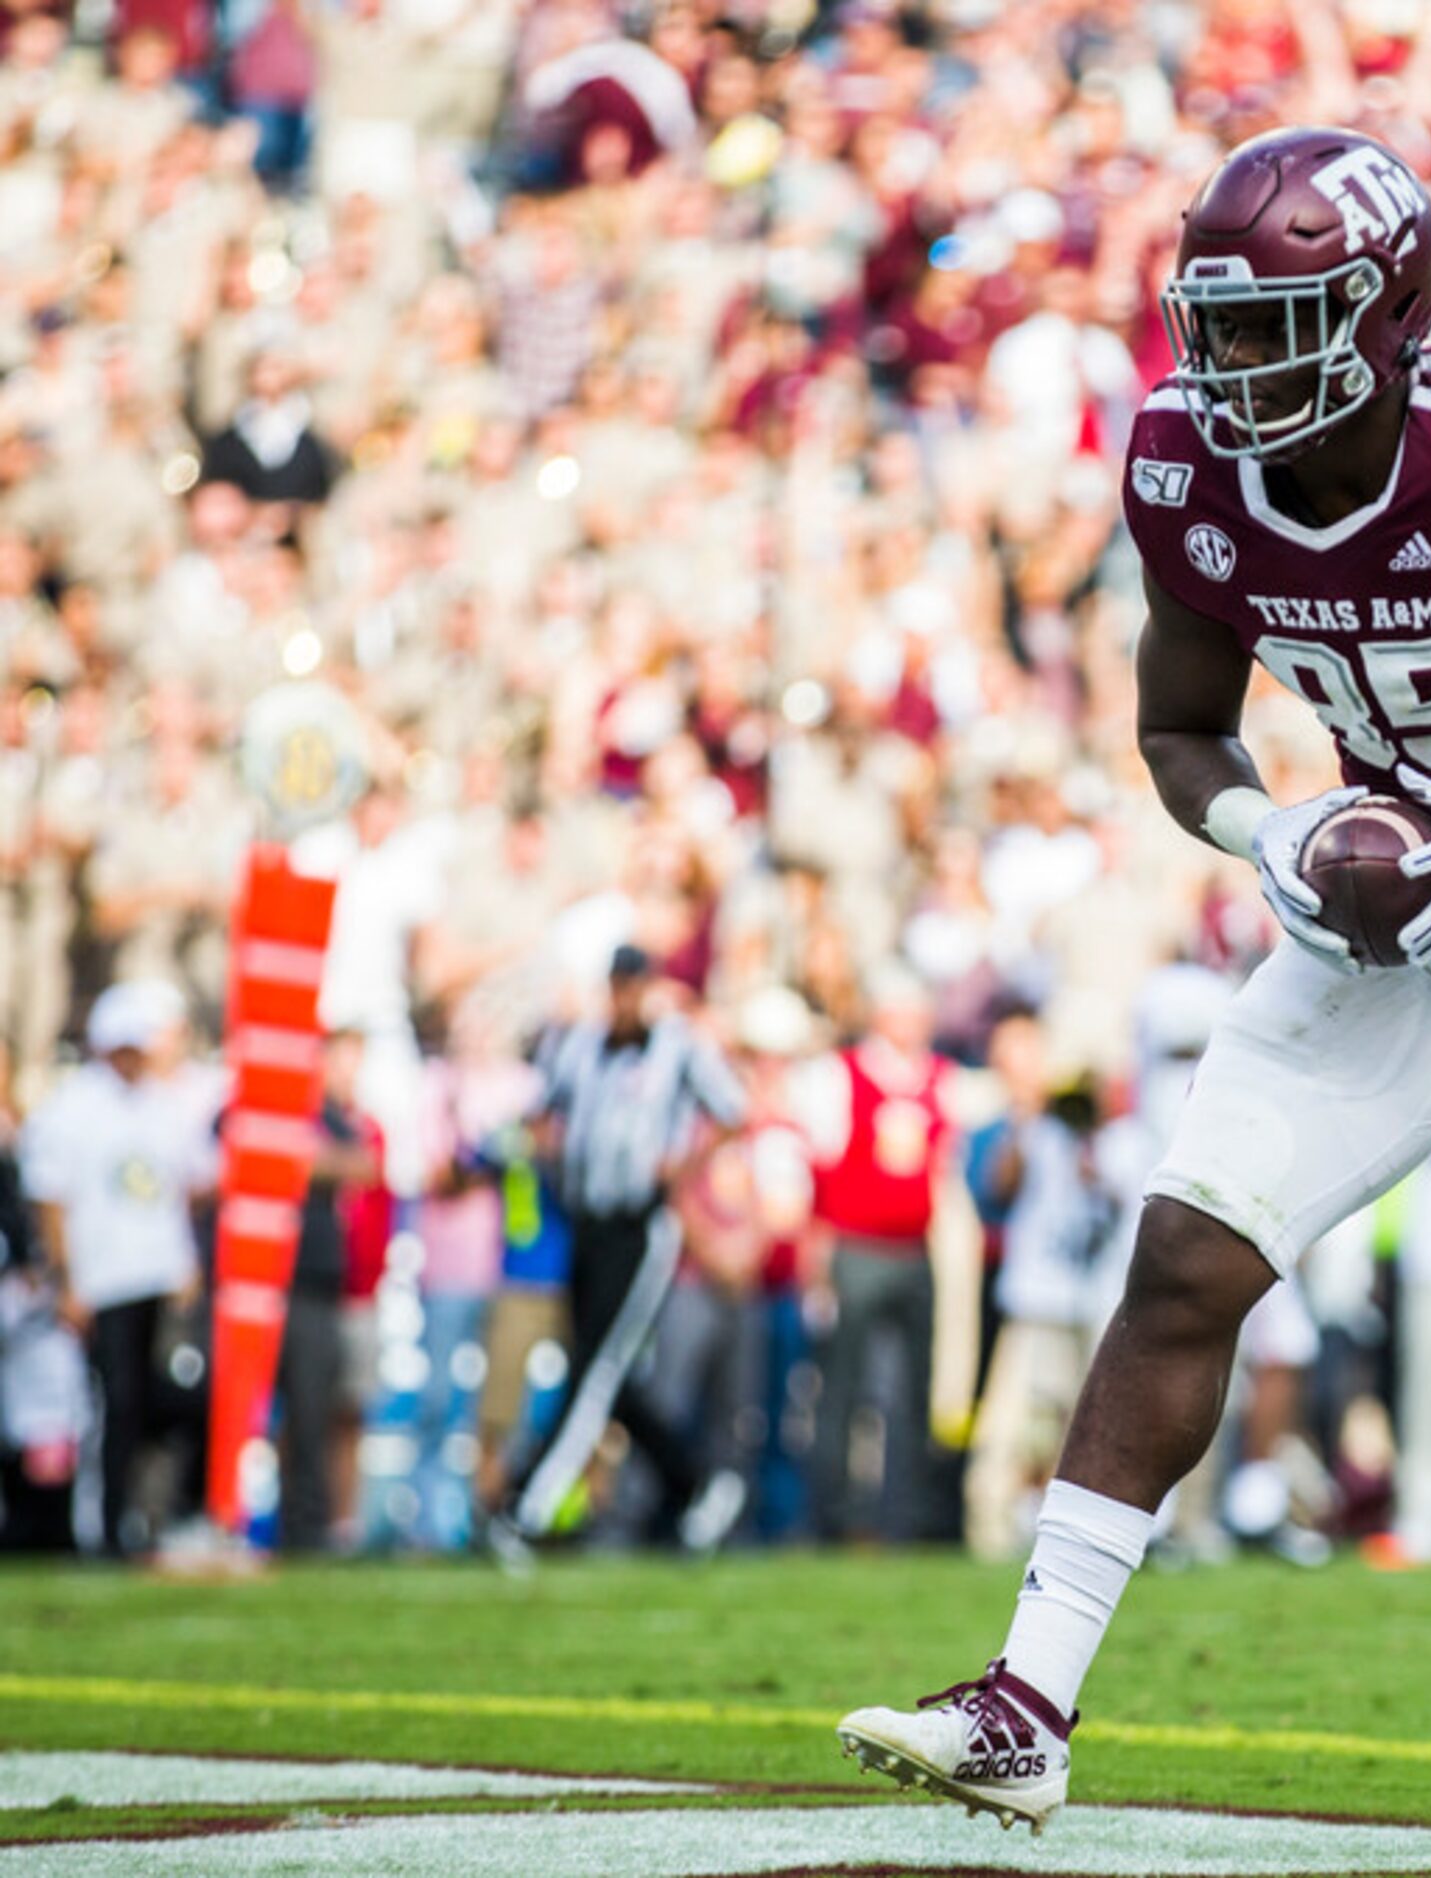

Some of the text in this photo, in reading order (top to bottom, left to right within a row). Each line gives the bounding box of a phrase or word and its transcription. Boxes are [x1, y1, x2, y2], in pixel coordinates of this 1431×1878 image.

[1188, 528, 1232, 577] SEC
[1246, 595, 1361, 631] TEXAS
[952, 1750, 1047, 1781] adidas
